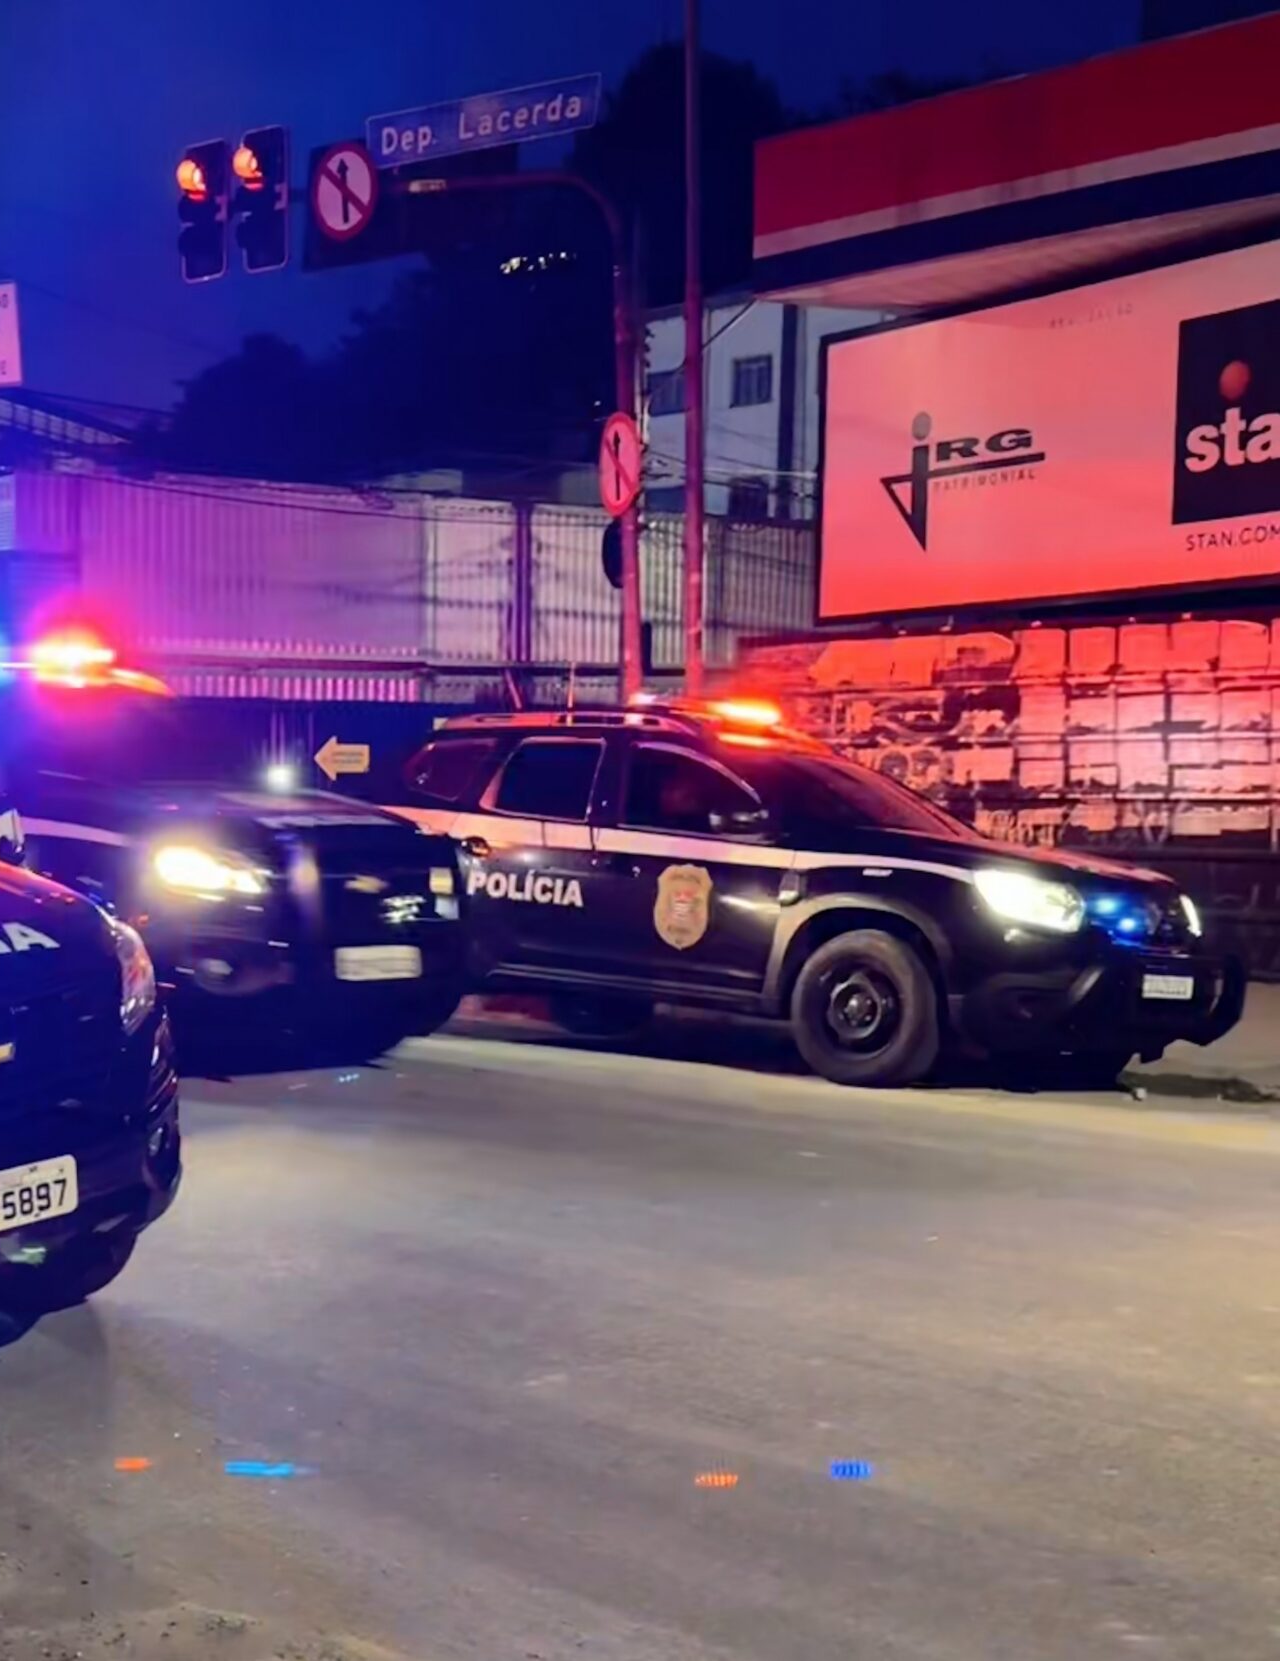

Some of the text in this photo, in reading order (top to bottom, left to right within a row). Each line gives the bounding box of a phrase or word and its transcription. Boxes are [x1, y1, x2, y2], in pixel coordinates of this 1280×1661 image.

[380, 93, 583, 155] Dep. Lacerda
[932, 469, 1037, 491] PATRIMONIAL
[467, 870, 584, 908] POLÍCIA
